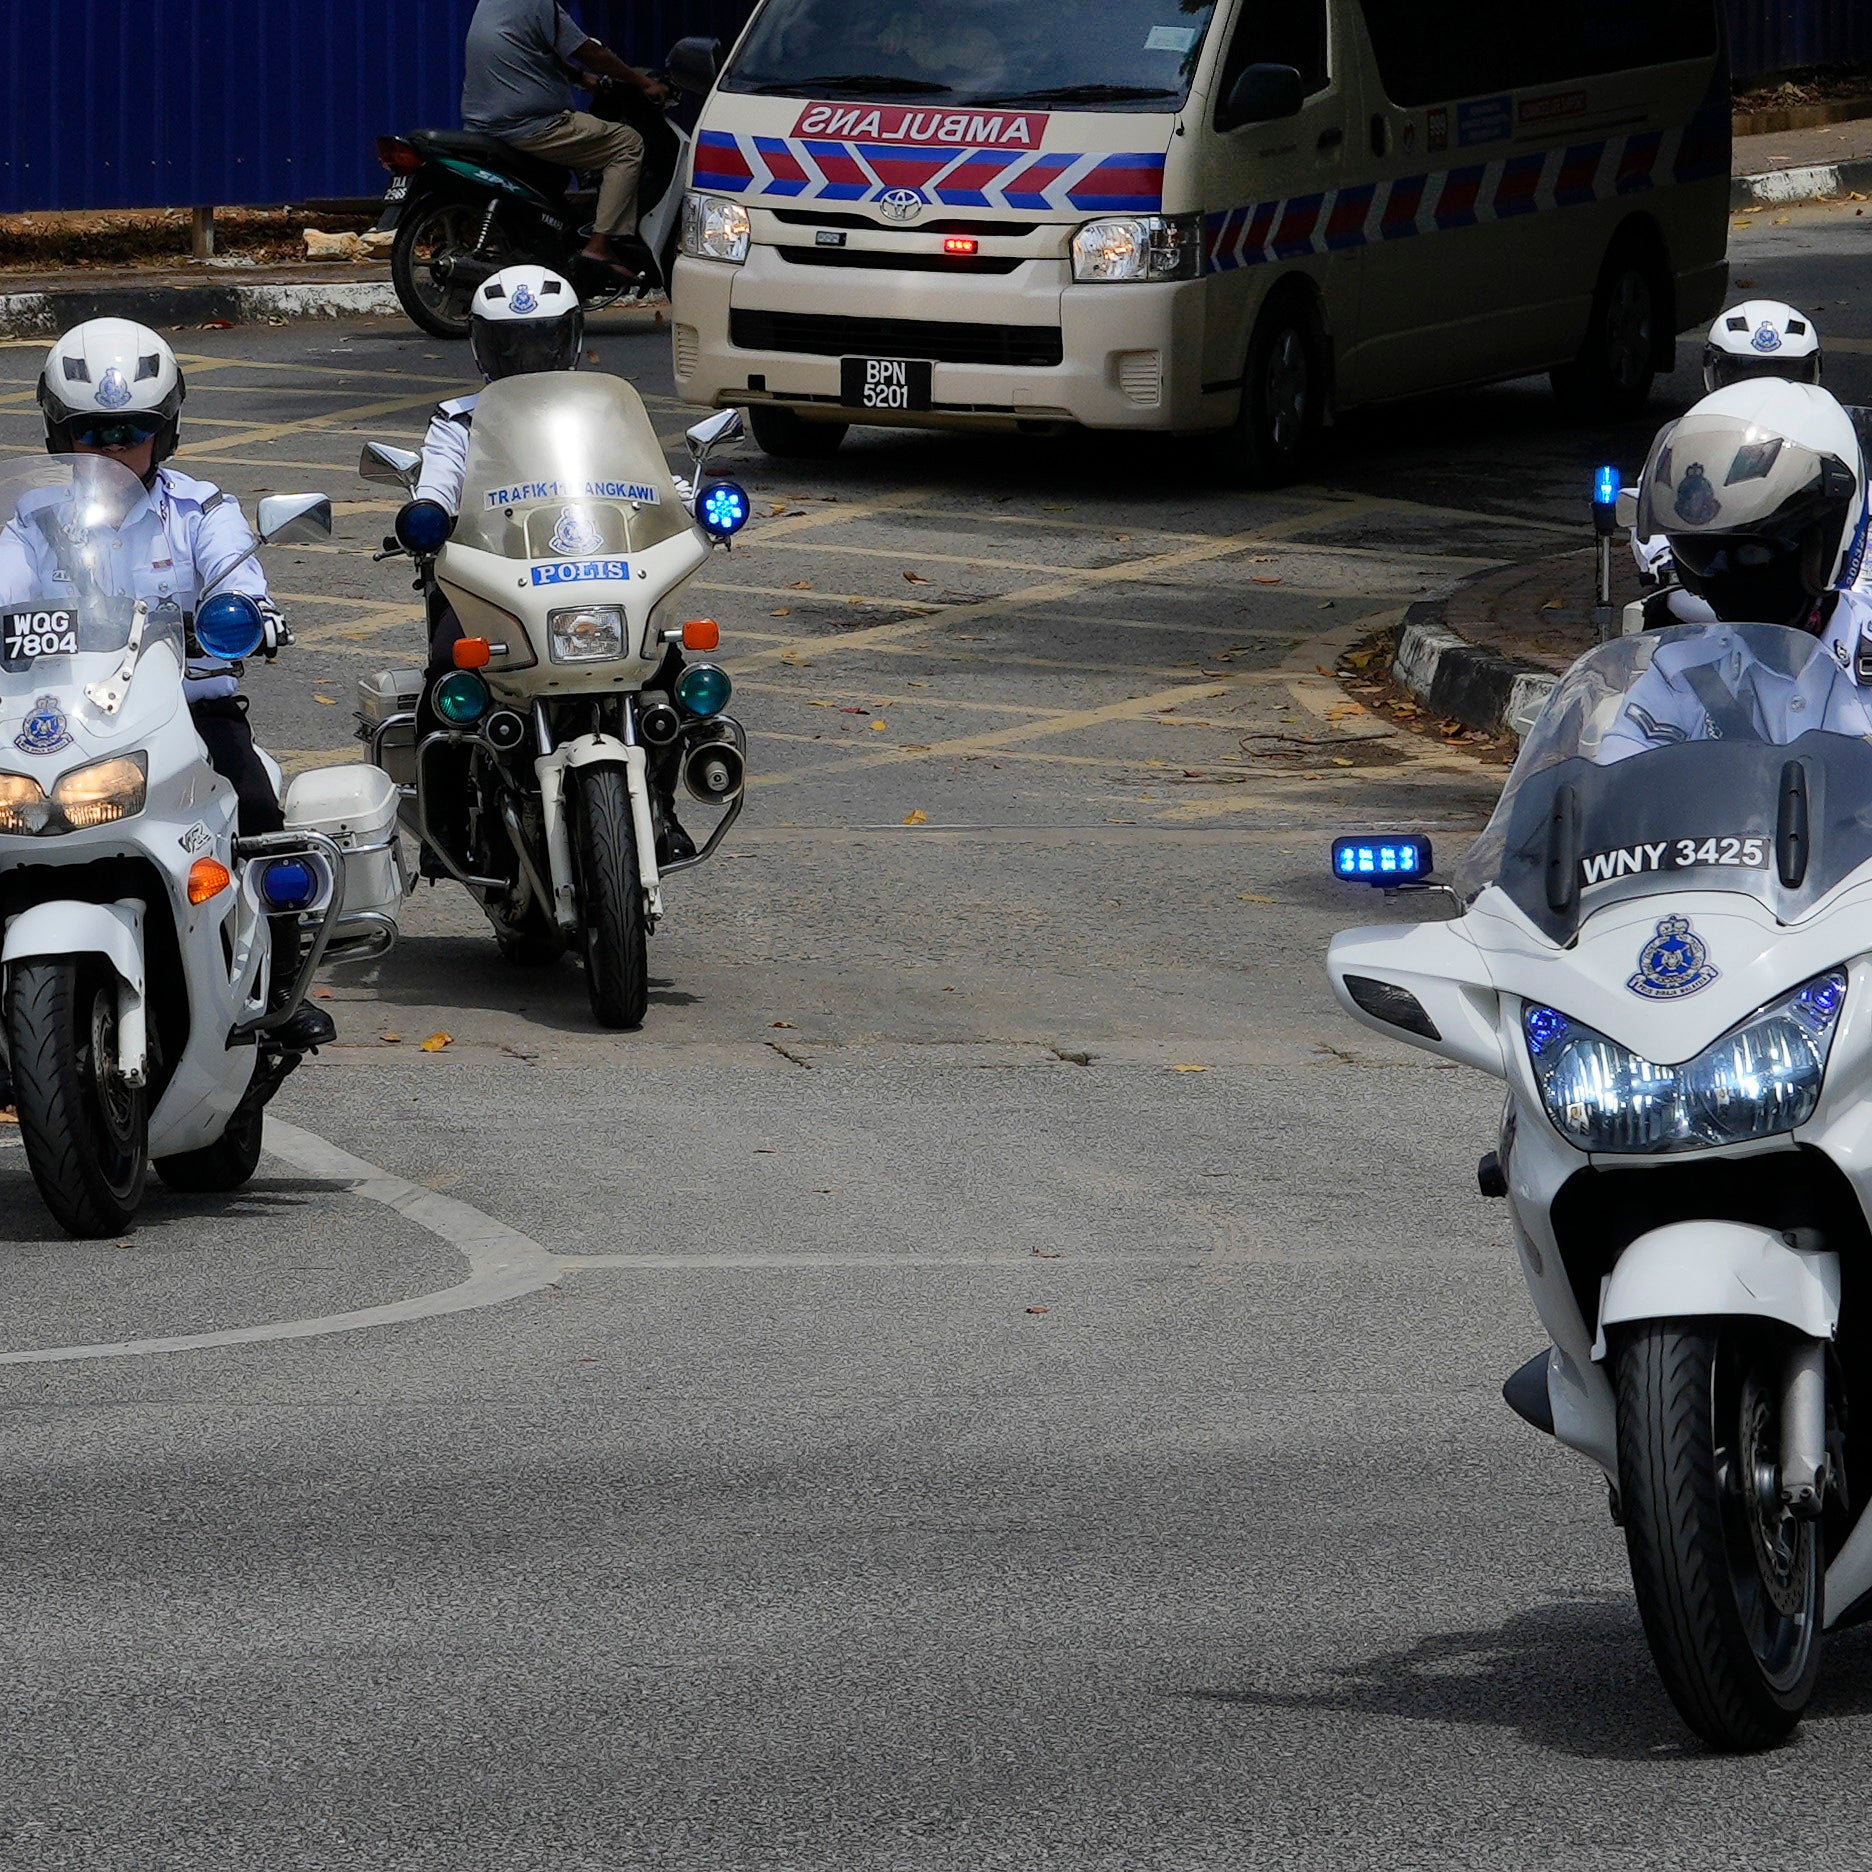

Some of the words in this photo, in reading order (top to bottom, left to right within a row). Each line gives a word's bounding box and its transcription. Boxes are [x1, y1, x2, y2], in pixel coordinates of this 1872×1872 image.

[866, 360, 906, 385] BPN
[863, 383, 908, 408] 5201
[488, 481, 548, 506] TRAFIK
[581, 481, 655, 502] ANGKAWI
[537, 561, 624, 584] POLIS
[13, 610, 70, 636] WQG
[4, 631, 78, 659] 7804
[1582, 841, 1668, 884] WNY
[1674, 837, 1764, 867] 3425
